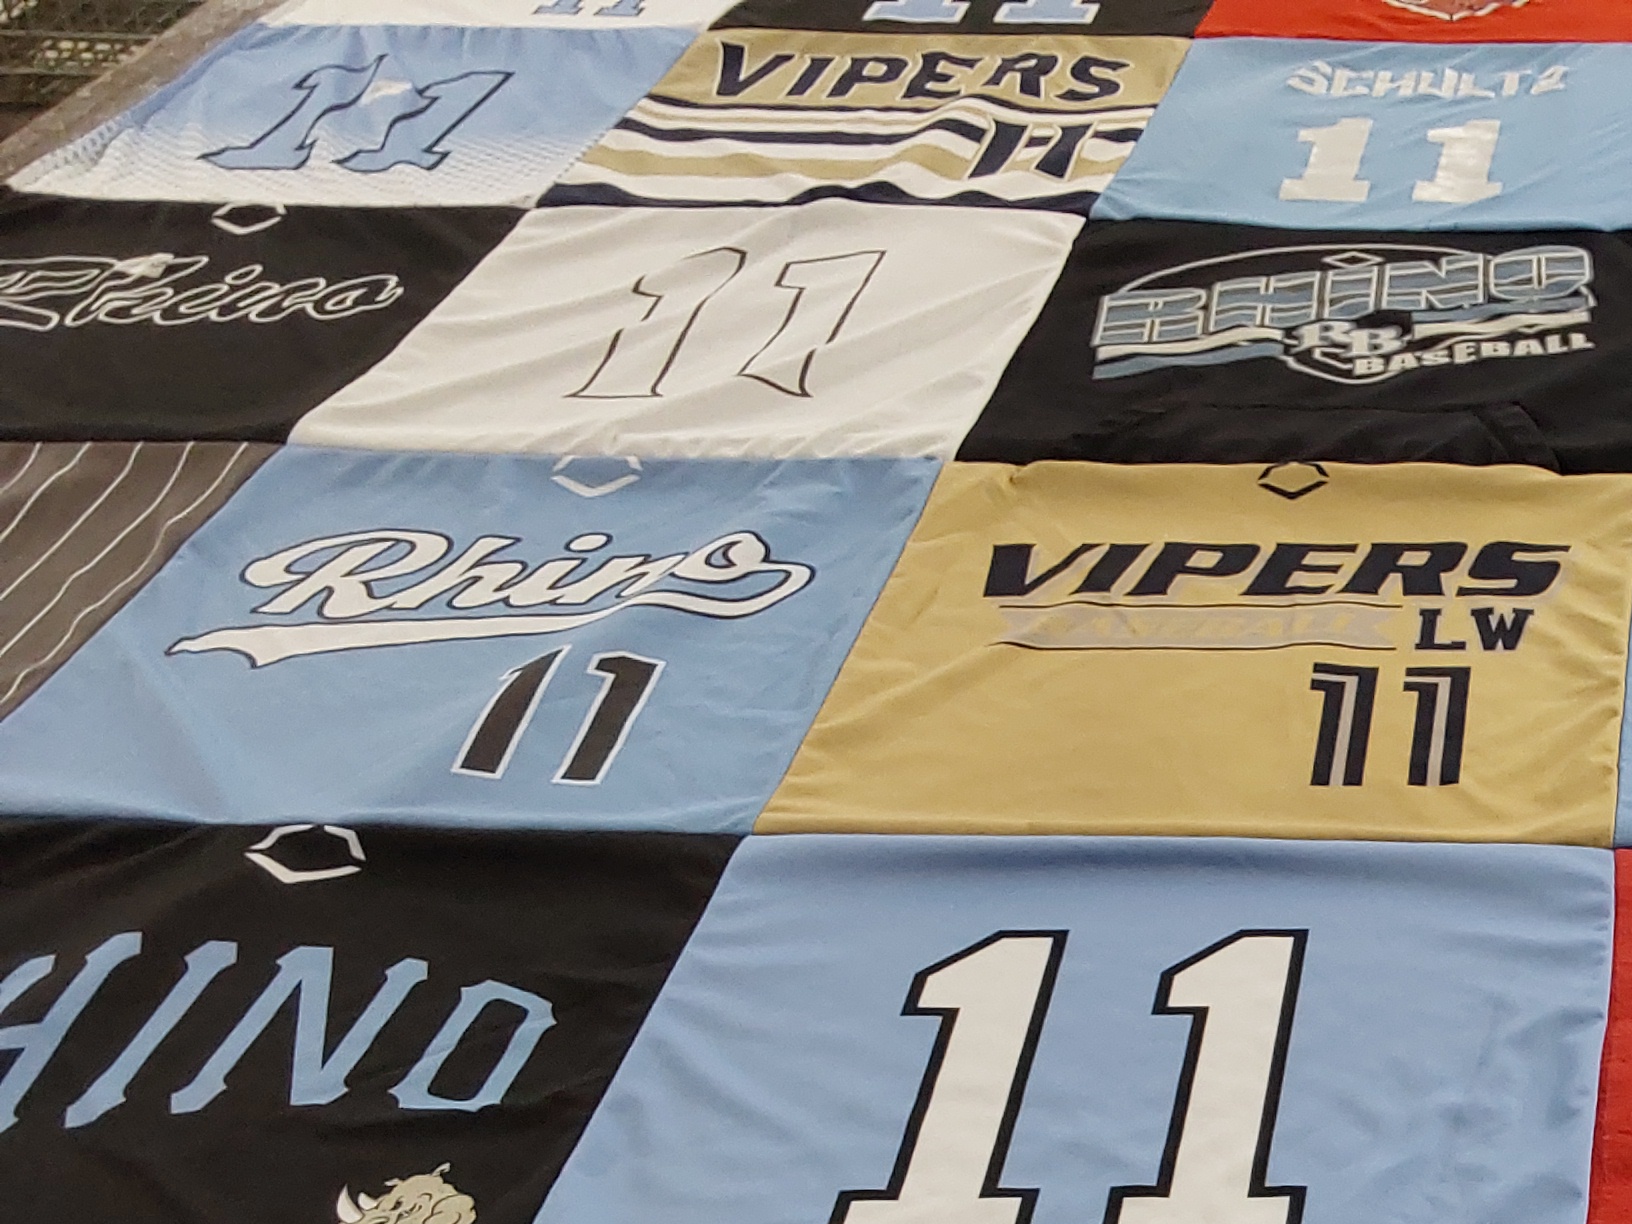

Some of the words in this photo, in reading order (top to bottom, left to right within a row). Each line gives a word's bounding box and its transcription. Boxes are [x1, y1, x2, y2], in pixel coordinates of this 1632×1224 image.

[199, 54, 516, 171] 11
[712, 40, 1132, 101] VIPERS
[1286, 60, 1570, 98] SCHULTZ
[964, 115, 1097, 181] 11
[1278, 117, 1503, 203] 11
[562, 246, 888, 399] 11
[1091, 245, 1597, 346] RHINO
[1353, 332, 1595, 377] BASEBALL
[236, 528, 816, 624] Rhino
[982, 541, 1573, 599] VIPERS
[1414, 607, 1536, 653] LW
[451, 643, 667, 786] 11
[1309, 662, 1472, 788] 11
